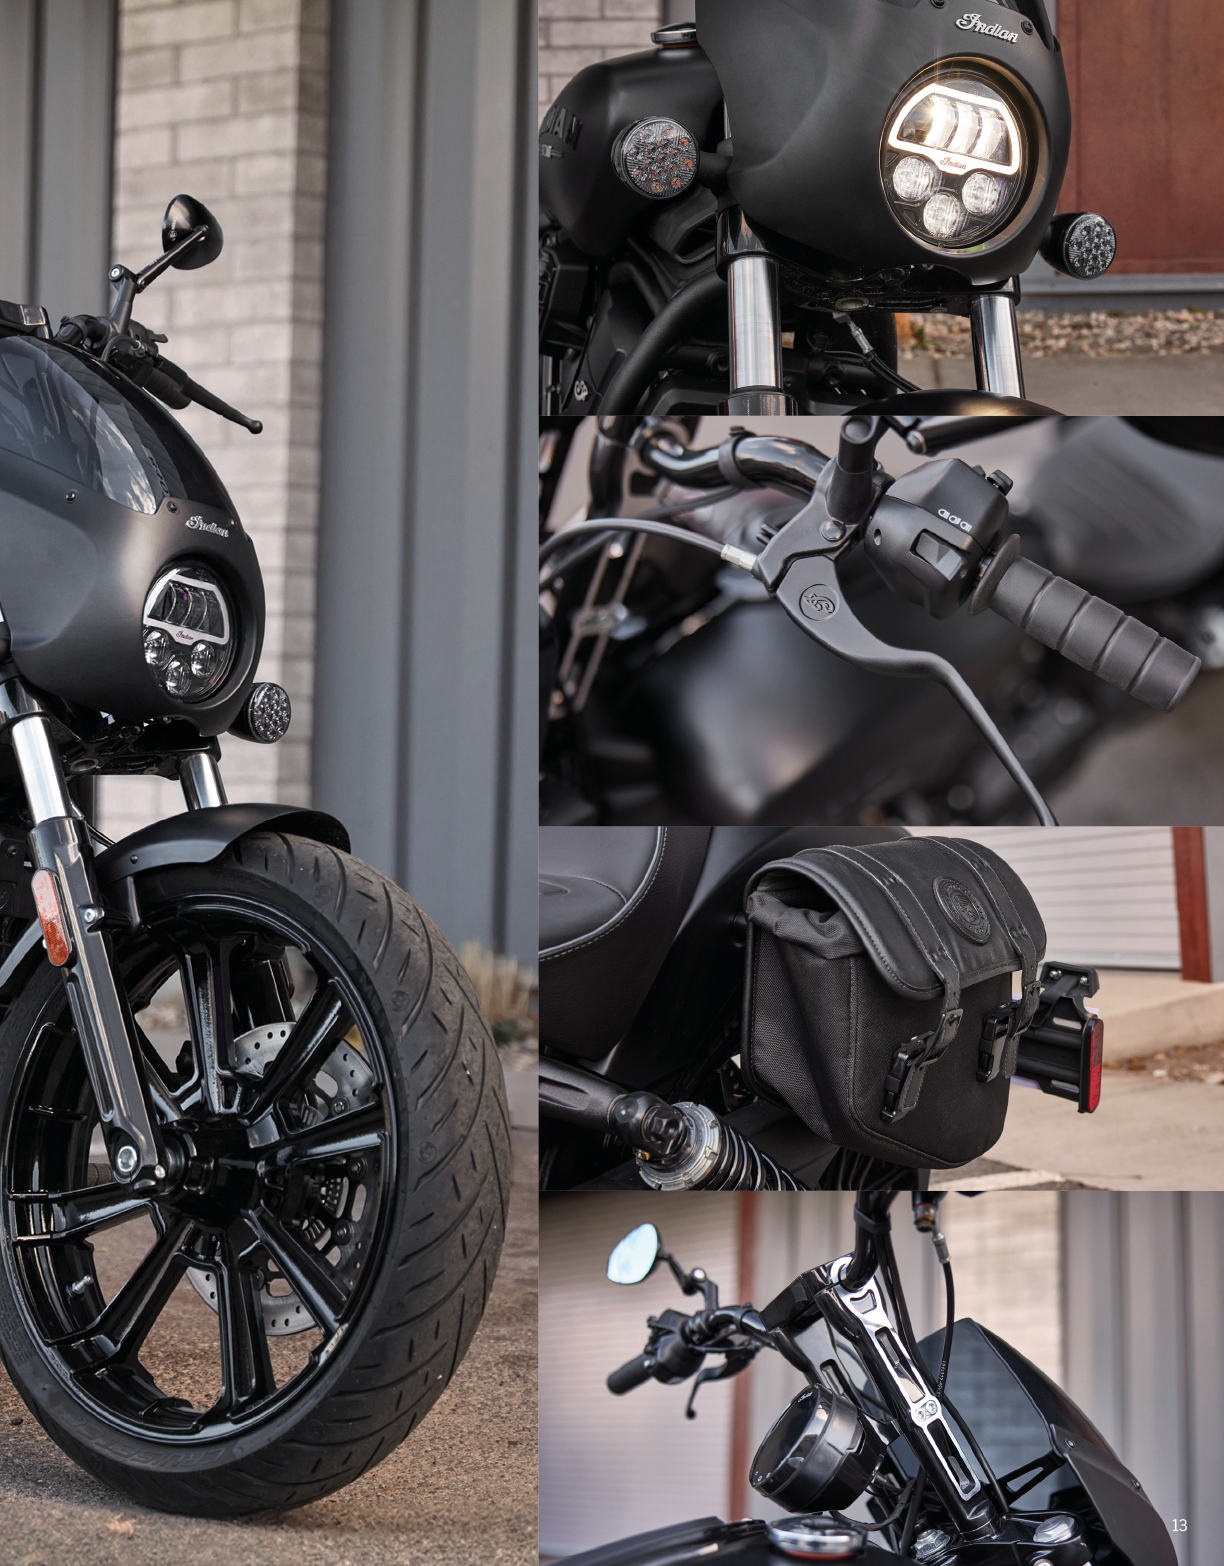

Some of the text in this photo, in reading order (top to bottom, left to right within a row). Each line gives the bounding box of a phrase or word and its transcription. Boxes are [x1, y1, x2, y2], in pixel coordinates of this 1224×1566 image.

[955, 13, 1018, 43] Indian
[939, 157, 967, 169] Indian
[185, 515, 229, 537] Indian
